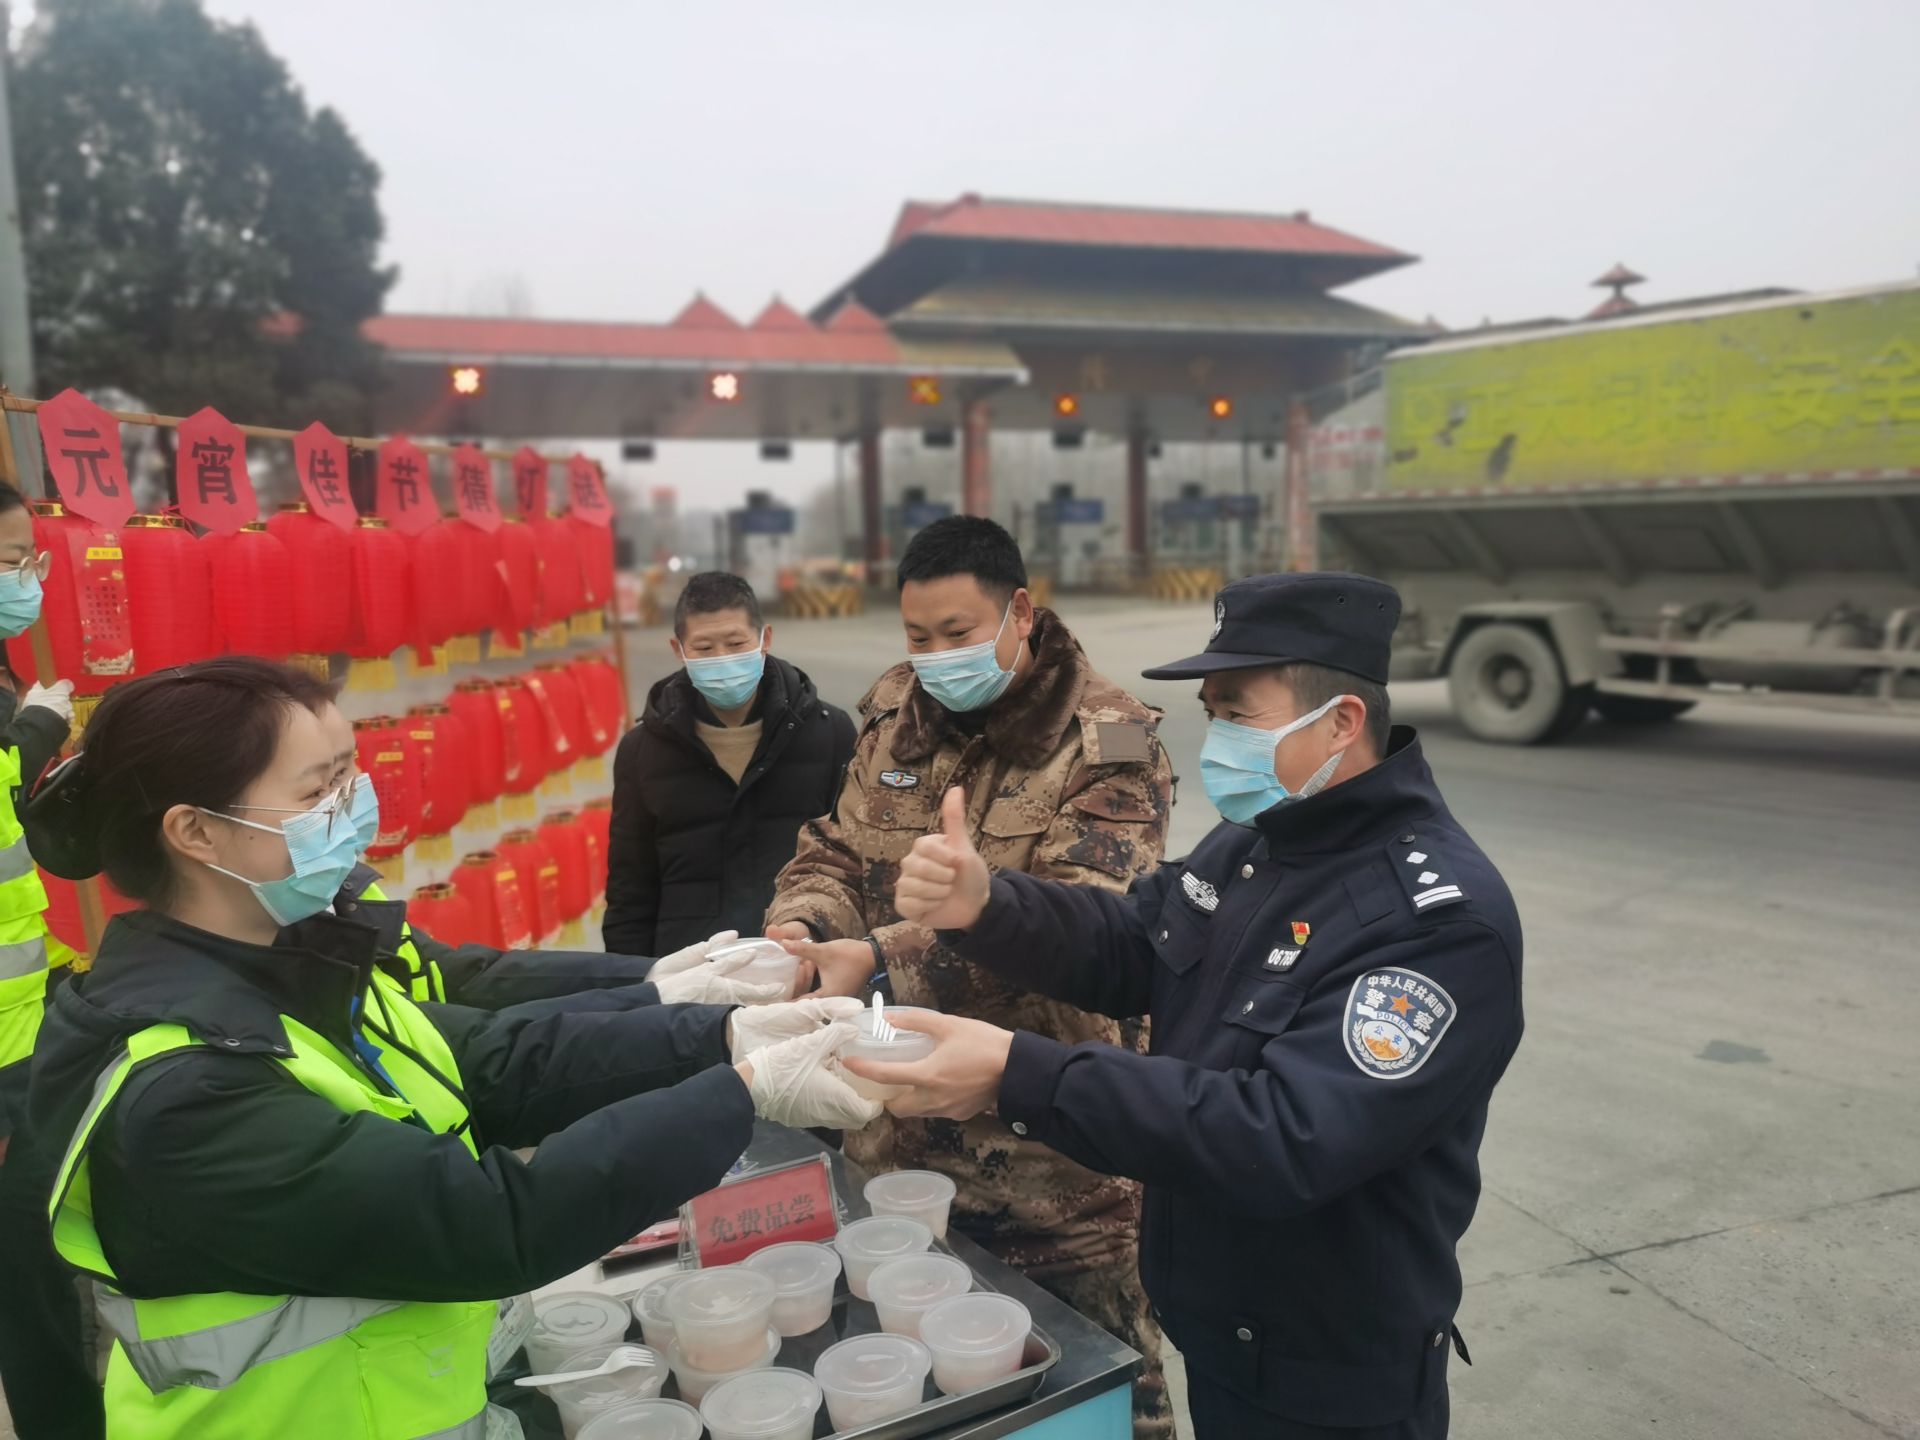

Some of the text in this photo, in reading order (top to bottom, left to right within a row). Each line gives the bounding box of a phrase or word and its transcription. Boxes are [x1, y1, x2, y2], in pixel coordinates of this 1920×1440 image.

[1367, 975, 1446, 1018] 中华人民共和国
[1376, 1012, 1412, 1034] POLICE
[710, 1193, 816, 1247] 免费品尝
